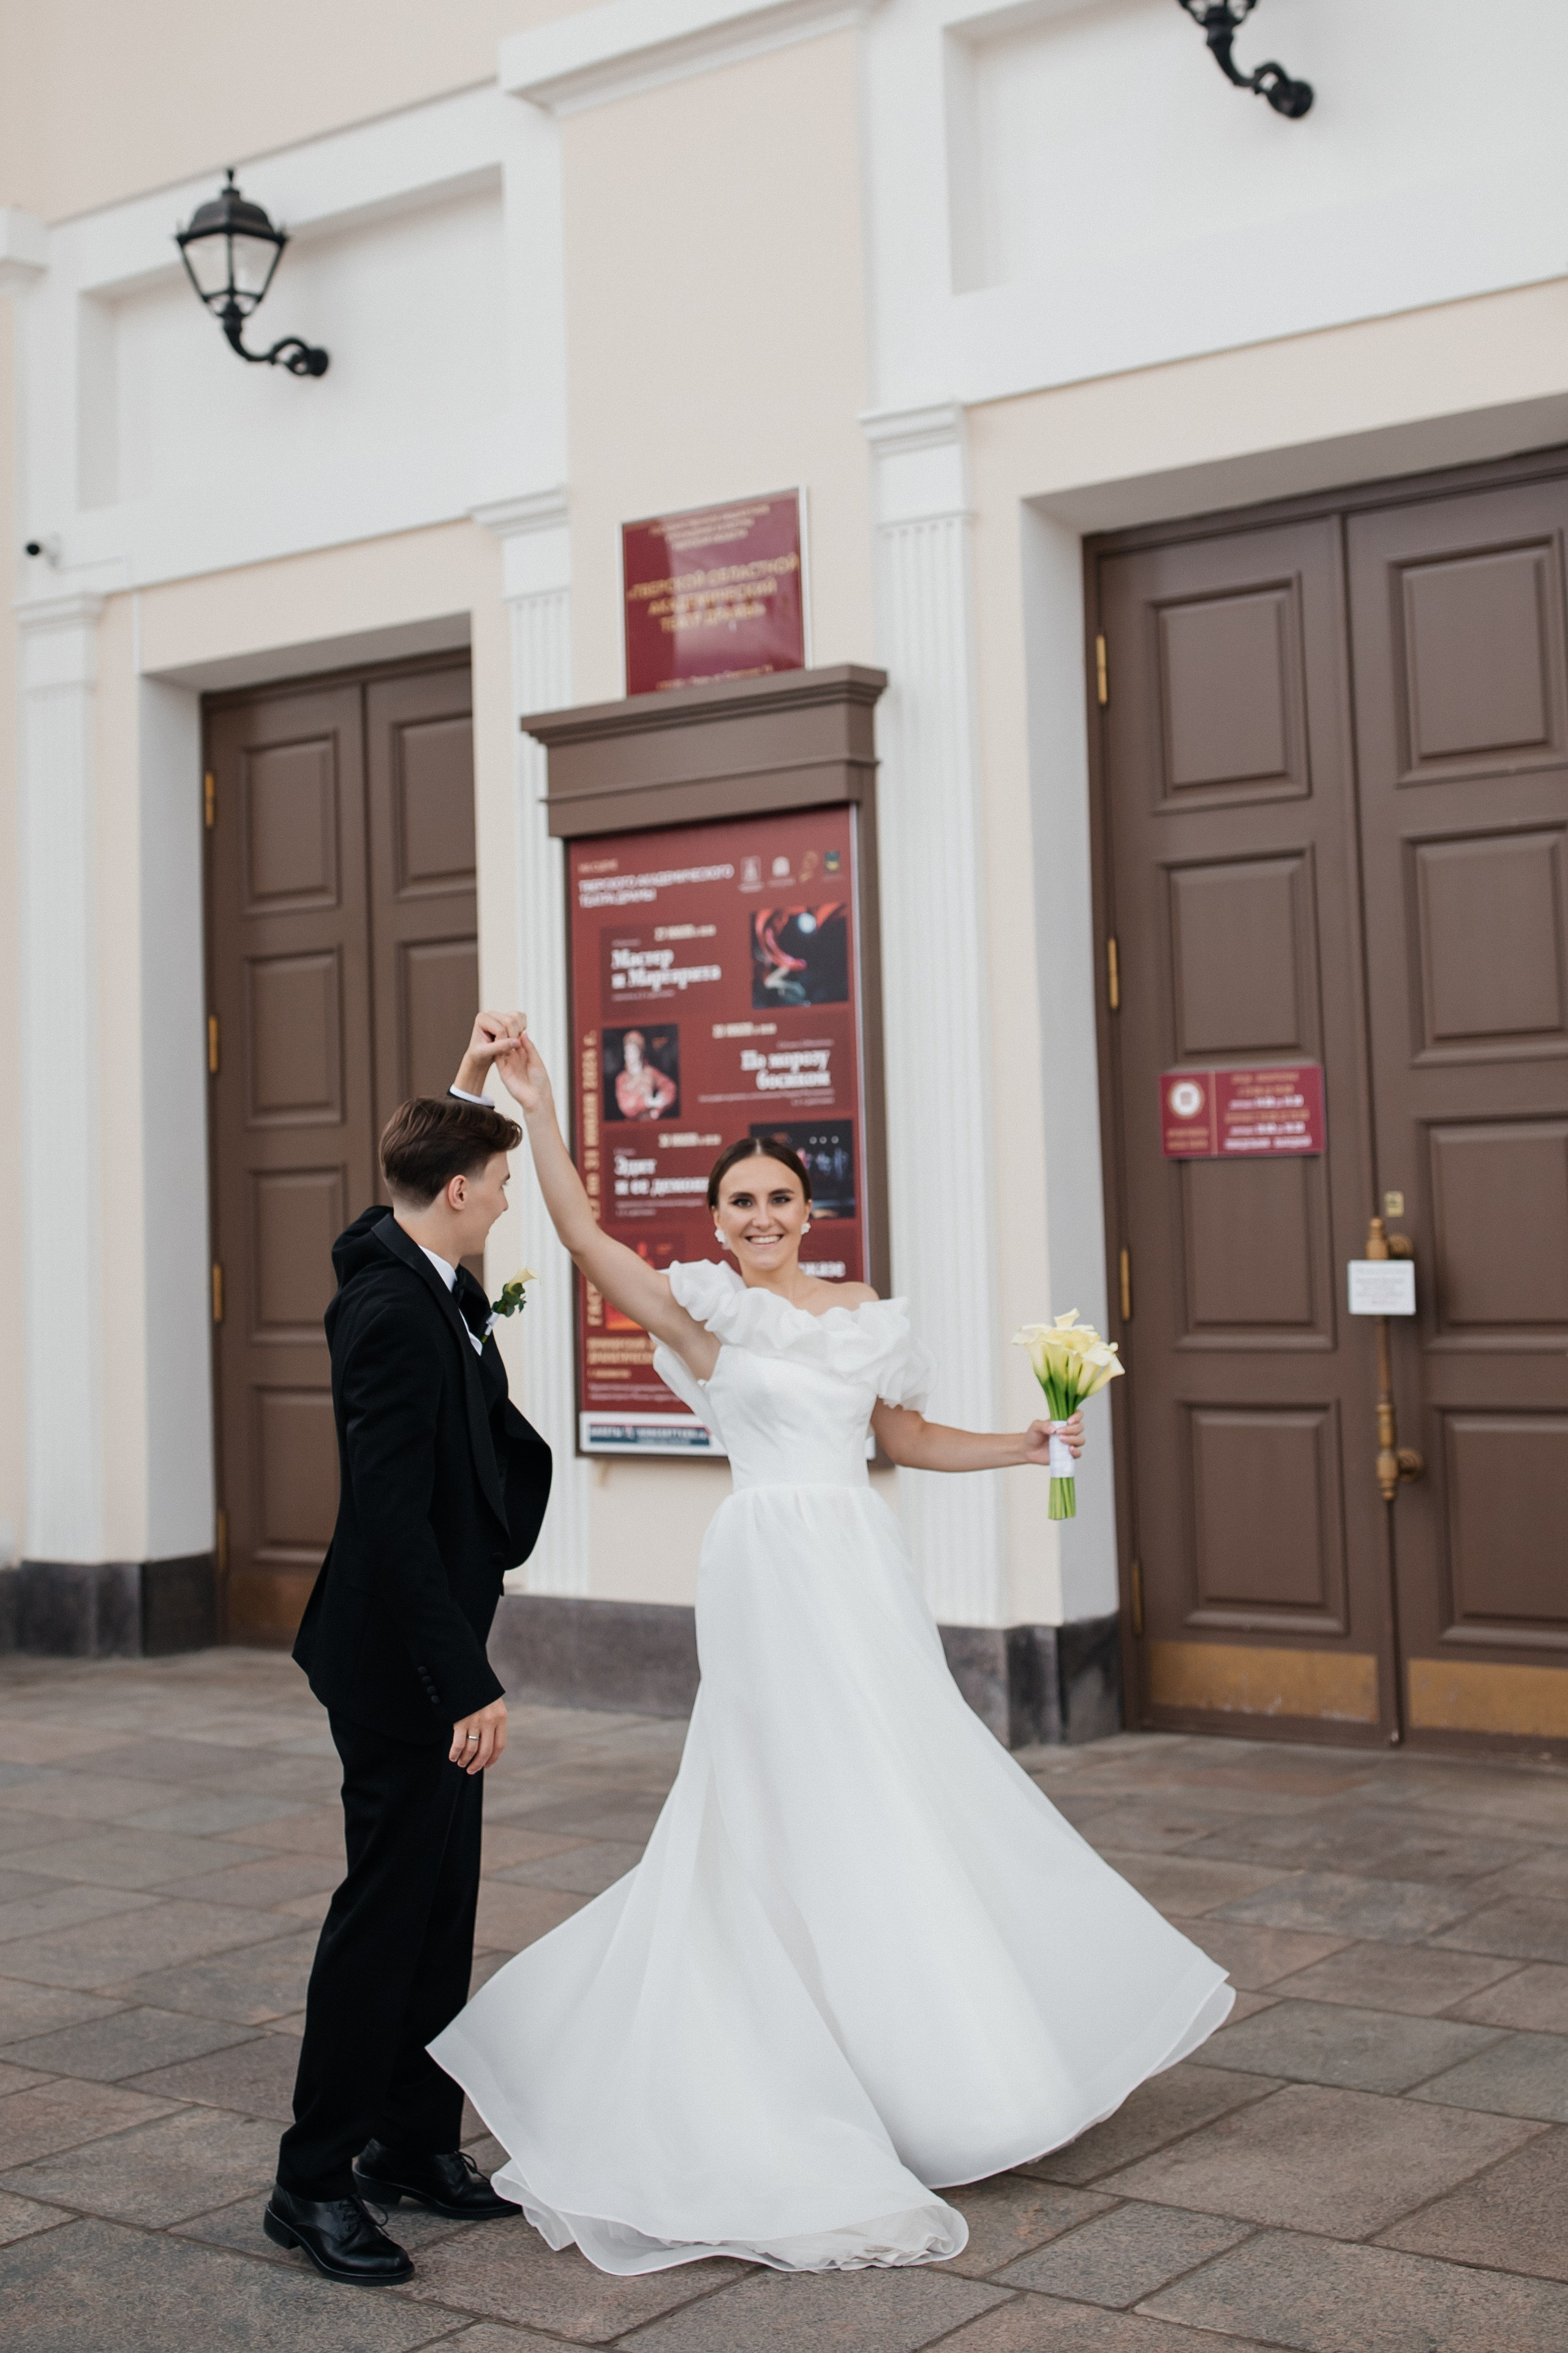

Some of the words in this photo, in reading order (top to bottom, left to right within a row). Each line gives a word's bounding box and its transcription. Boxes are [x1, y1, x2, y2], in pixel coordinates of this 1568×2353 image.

[610, 948, 675, 971] Мастер
[627, 964, 722, 993] Маргарита
[767, 1049, 832, 1074] морозу
[755, 1068, 832, 1090] босиком
